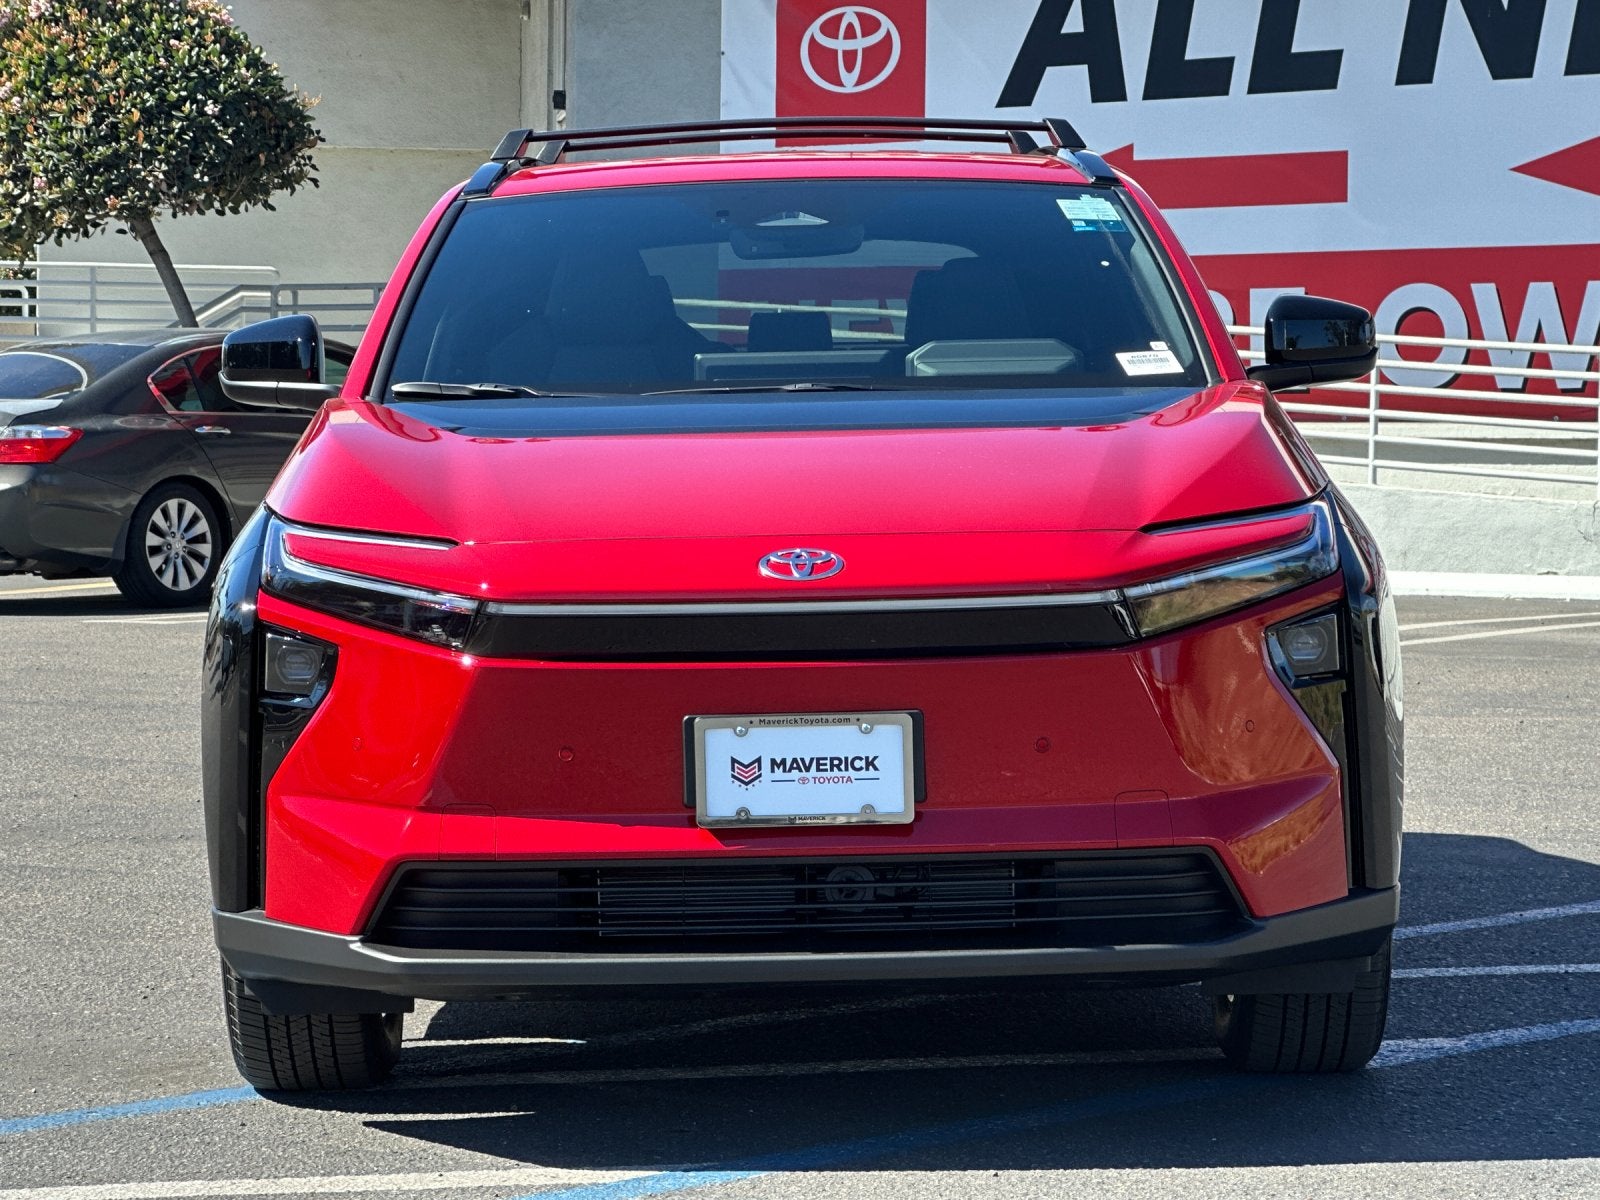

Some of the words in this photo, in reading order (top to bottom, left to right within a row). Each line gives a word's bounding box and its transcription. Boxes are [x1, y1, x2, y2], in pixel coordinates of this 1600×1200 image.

[995, 0, 1344, 108] ALL
[758, 716, 851, 726] MaverickToyota.com
[770, 755, 880, 774] MAVERICK
[811, 776, 854, 785] TOYOTA
